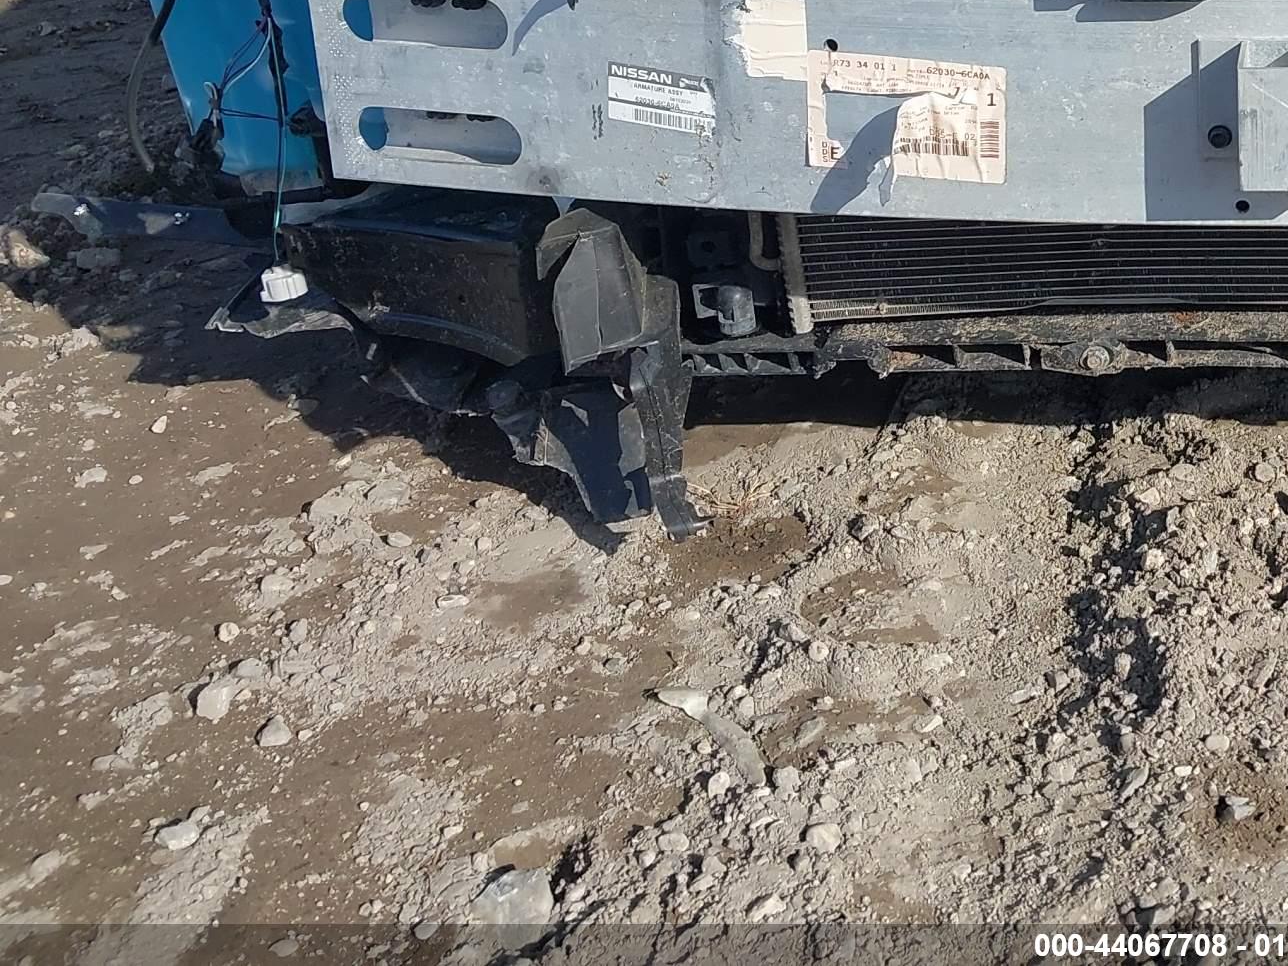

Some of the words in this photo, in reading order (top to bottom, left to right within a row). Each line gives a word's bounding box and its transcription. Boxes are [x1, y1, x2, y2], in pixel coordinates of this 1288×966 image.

[856, 60, 868, 68] 34
[874, 61, 885, 71] 01
[611, 64, 672, 84] NISSAN
[926, 66, 991, 81] 62030-6CA0A
[633, 82, 666, 93] ARMATURE
[667, 89, 683, 97] ASSY
[986, 92, 996, 107] 1
[831, 145, 841, 161] E
